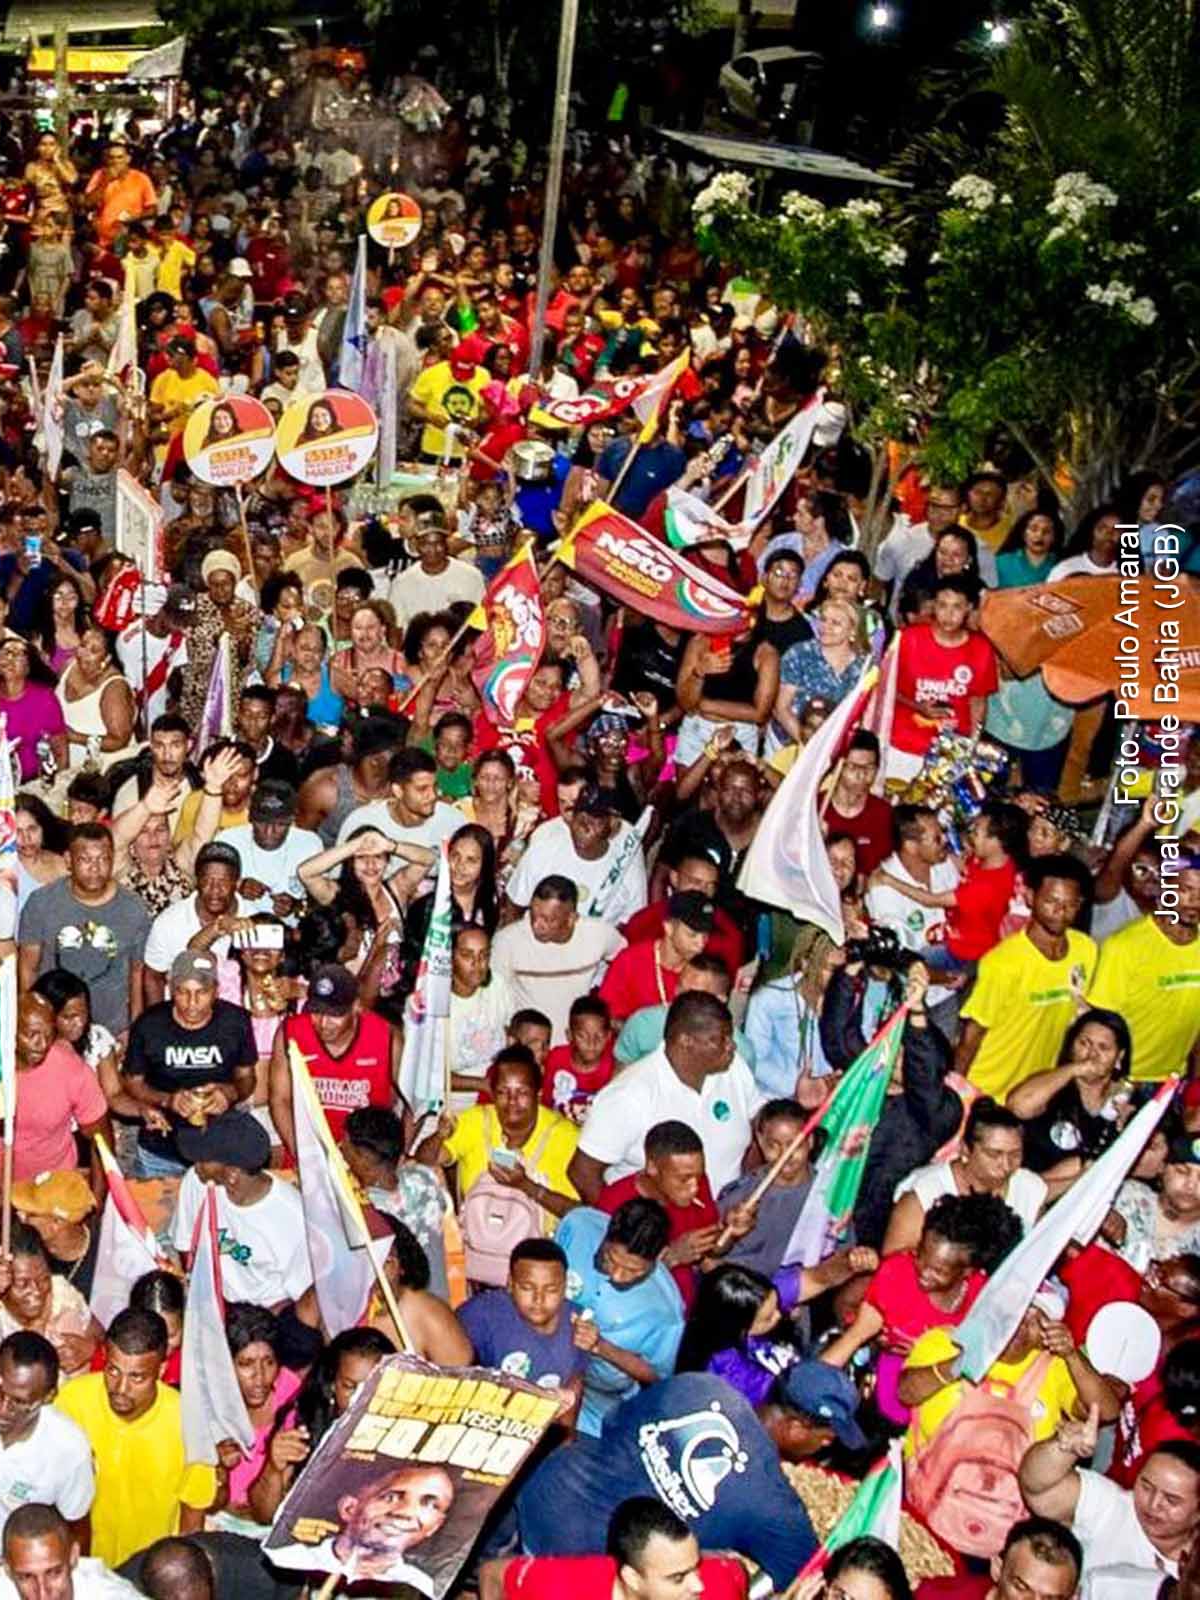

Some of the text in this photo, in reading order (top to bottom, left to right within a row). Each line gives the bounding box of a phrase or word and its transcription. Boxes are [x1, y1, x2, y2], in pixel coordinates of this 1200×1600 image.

[593, 531, 673, 583] Neto
[915, 678, 968, 697] UNIÃO
[165, 1046, 223, 1067] NASA
[344, 1413, 534, 1477] 50.000
